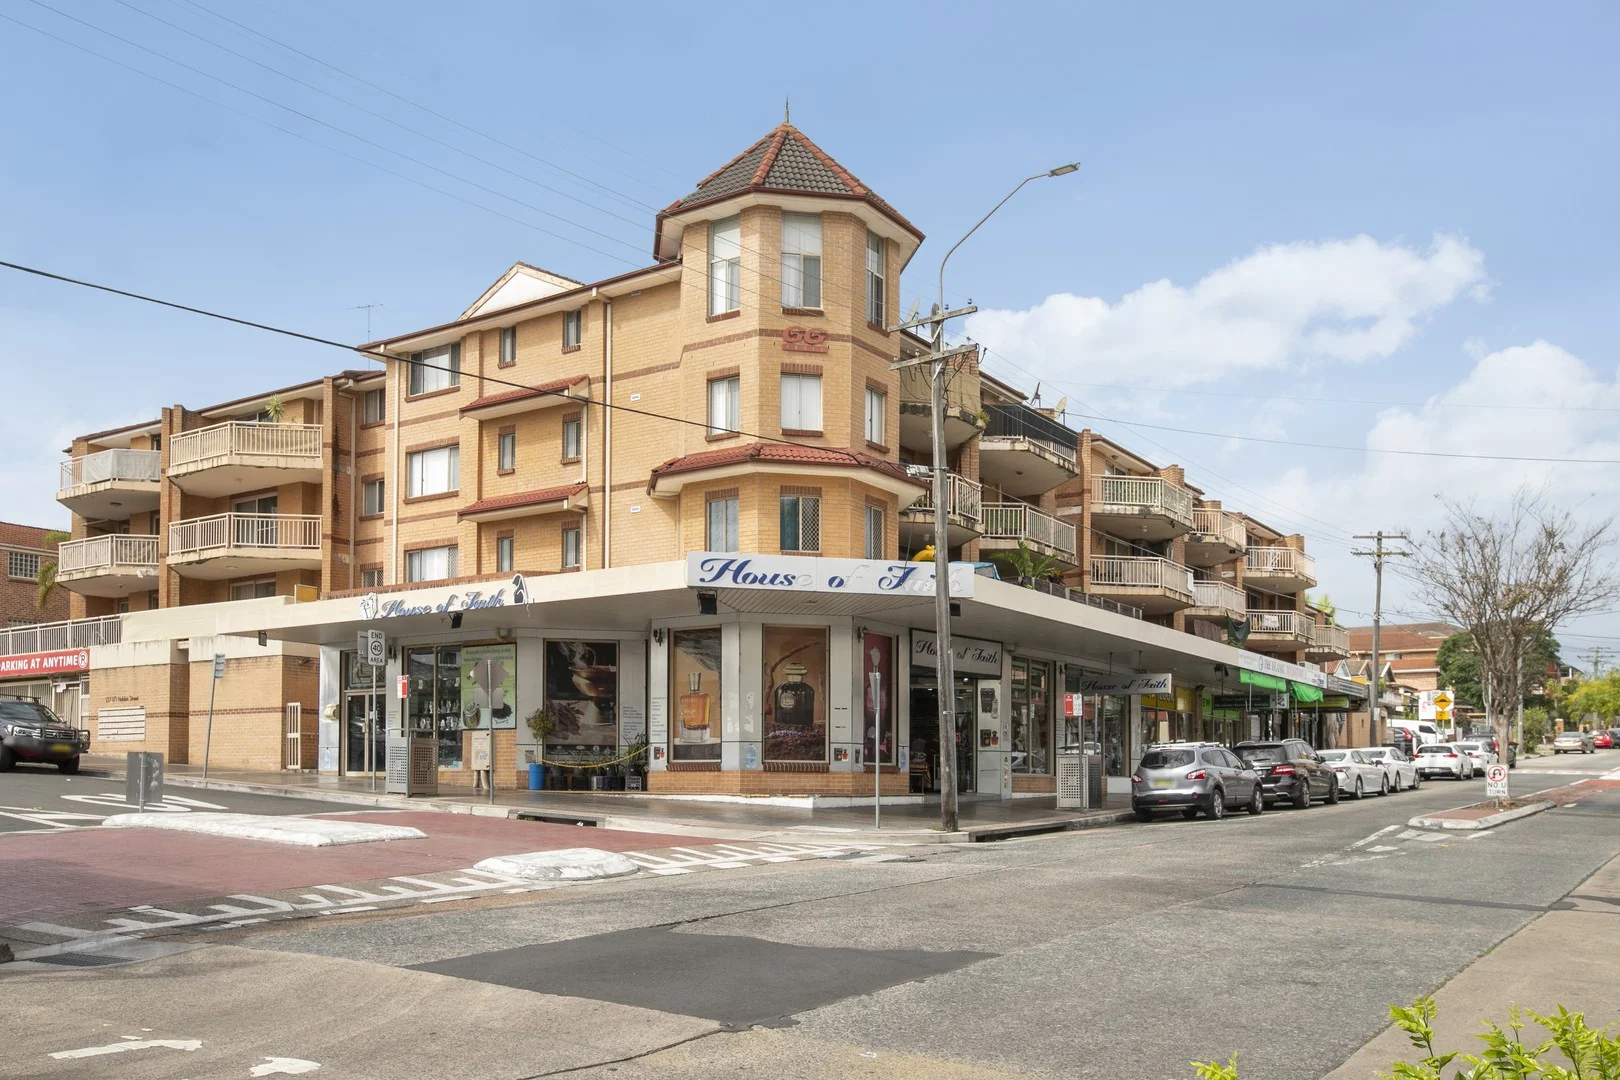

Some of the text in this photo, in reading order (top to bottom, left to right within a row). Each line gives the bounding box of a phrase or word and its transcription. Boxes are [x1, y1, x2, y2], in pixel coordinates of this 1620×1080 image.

[380, 600, 432, 618] House
[436, 594, 459, 613] of
[371, 631, 383, 640] END
[373, 644, 381, 652] 40
[370, 656, 383, 664] AREA
[956, 647, 999, 664] of Faith
[0, 659, 29, 672] ARKING
[30, 657, 41, 669] AT
[43, 654, 78, 668] ANYTIME
[1081, 678, 1167, 691] House of Faith
